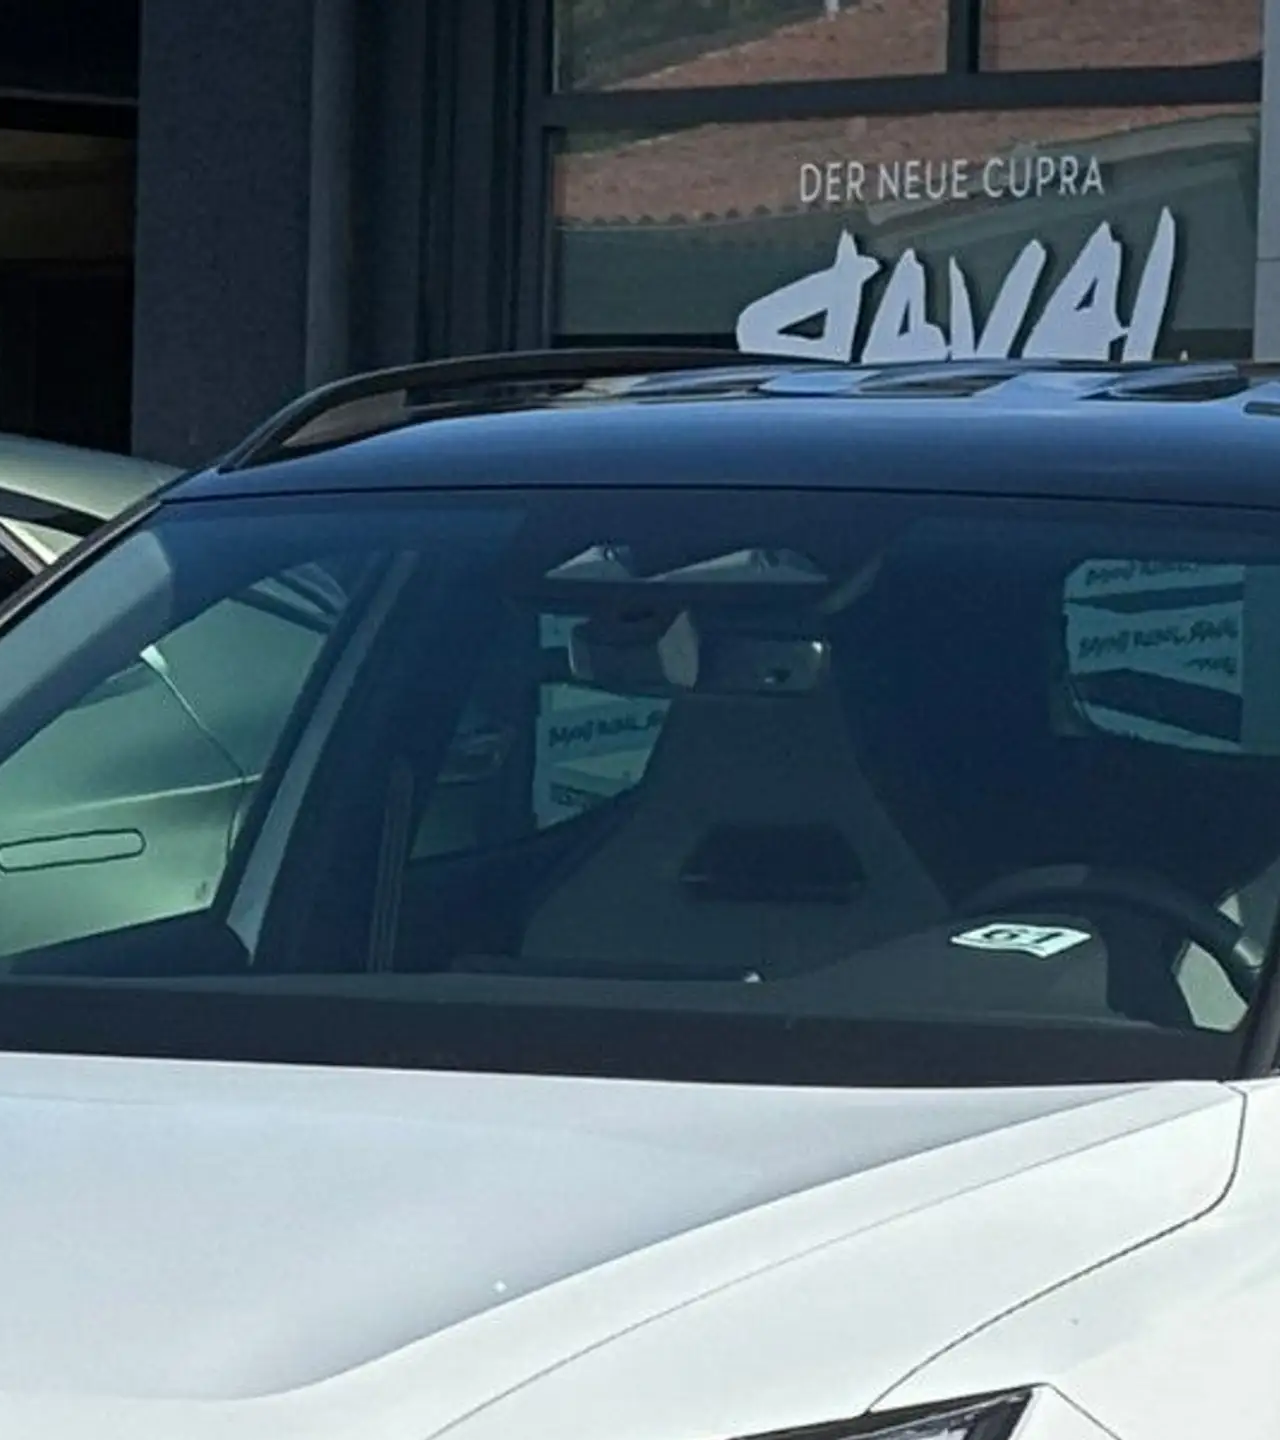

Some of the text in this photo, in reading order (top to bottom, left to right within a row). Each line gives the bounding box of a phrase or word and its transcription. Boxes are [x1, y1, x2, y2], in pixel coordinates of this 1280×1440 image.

[800, 154, 1105, 203] DER NEUE CUPRA
